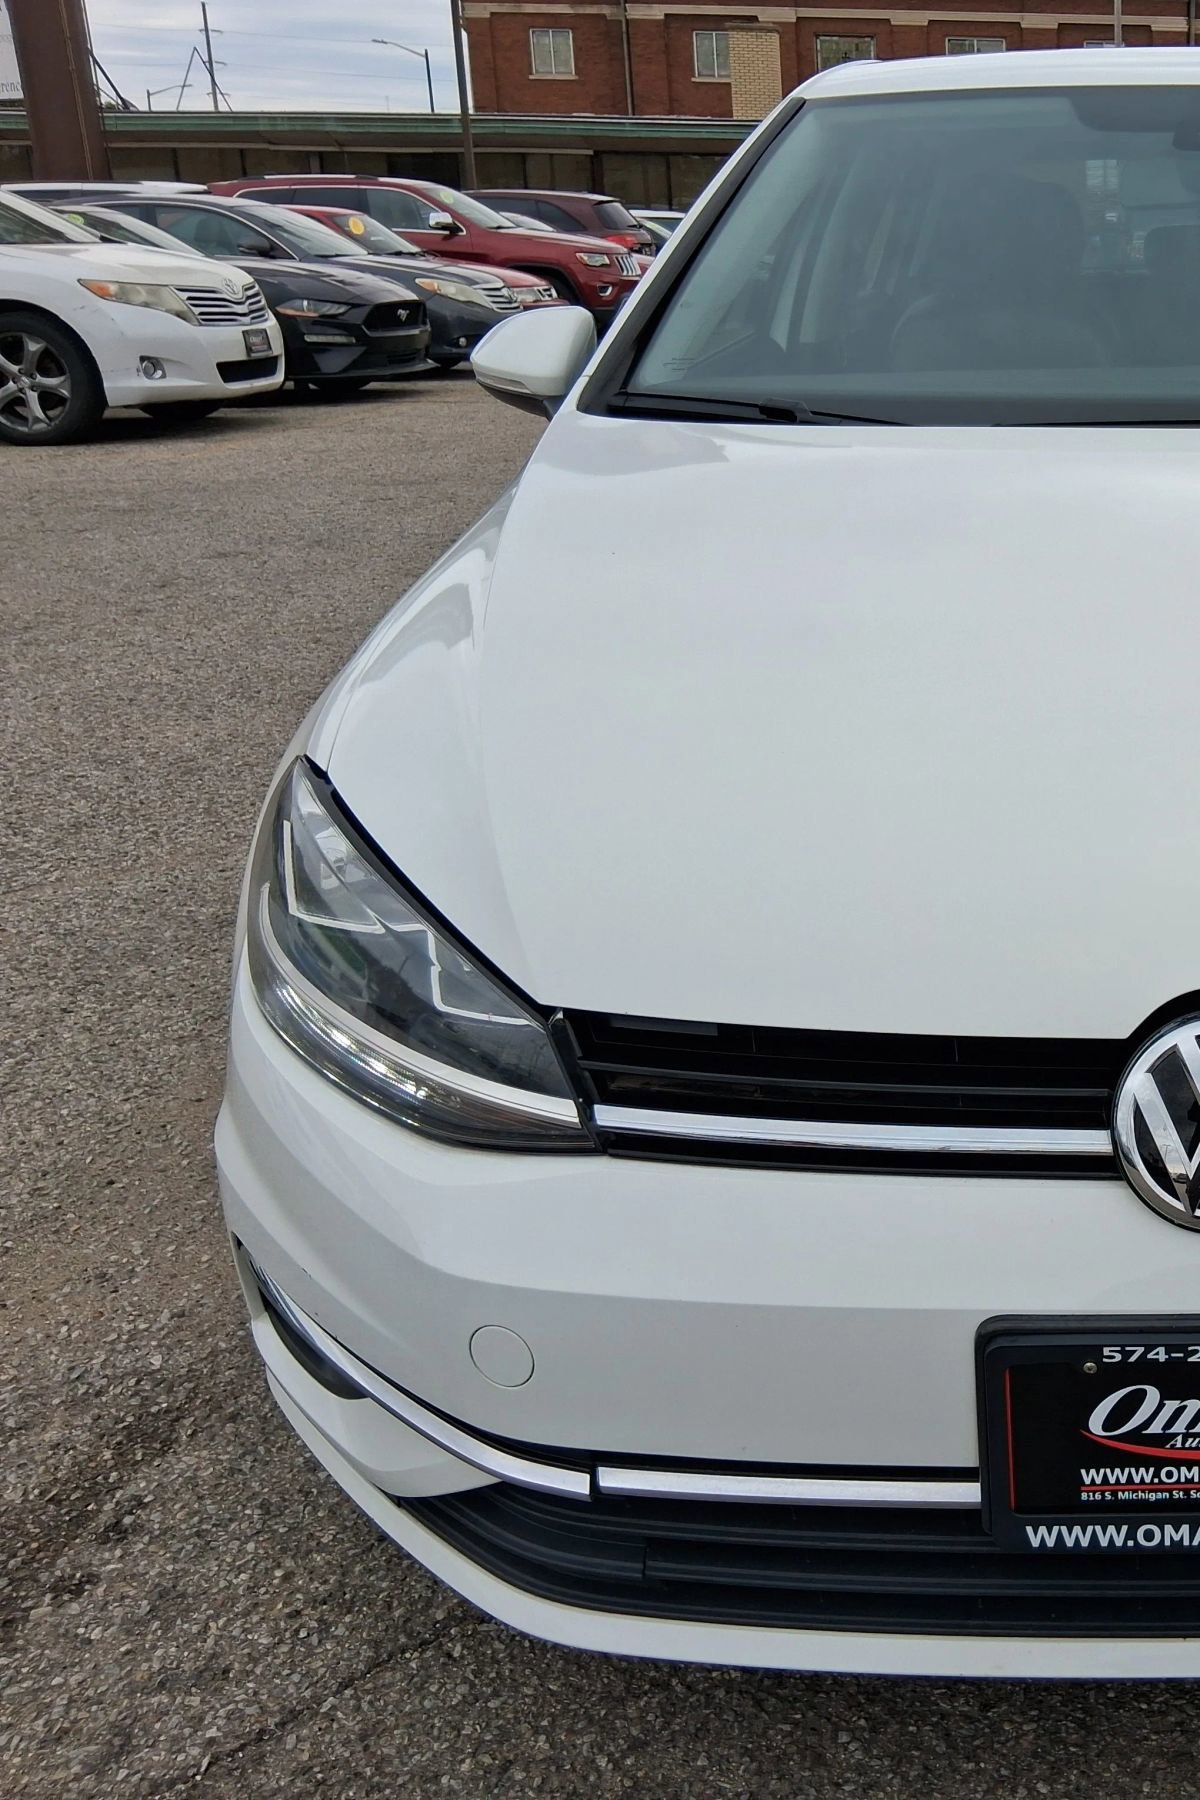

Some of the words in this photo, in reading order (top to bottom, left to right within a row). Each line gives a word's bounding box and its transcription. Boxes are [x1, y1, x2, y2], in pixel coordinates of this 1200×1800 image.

[1080, 1491, 1102, 1501] 816
[1104, 1491, 1115, 1501] S.
[1117, 1490, 1170, 1502] Michigan
[1172, 1490, 1188, 1500] St.
